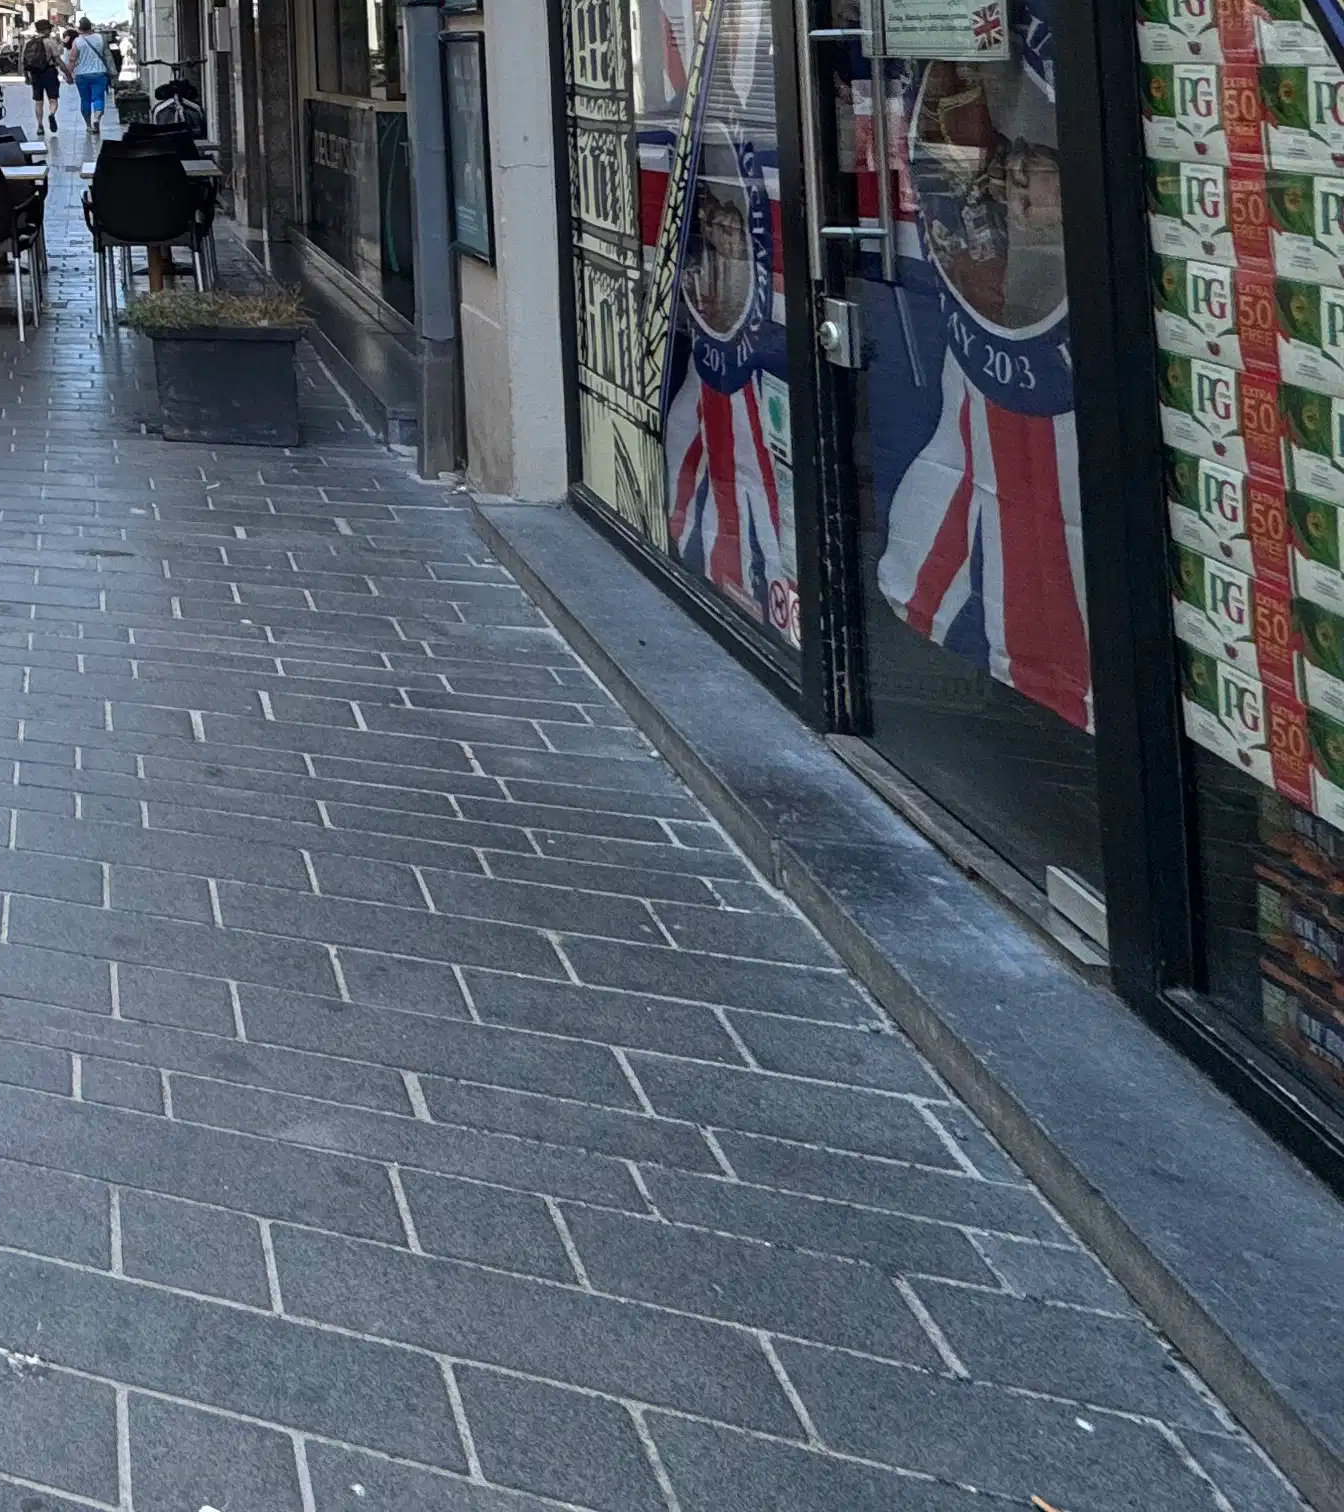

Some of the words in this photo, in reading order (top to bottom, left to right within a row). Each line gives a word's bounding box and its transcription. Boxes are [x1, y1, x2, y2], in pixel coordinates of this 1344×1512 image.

[1176, 77, 1212, 118] PG
[1223, 89, 1257, 120] 50
[1186, 176, 1220, 219] PG
[1231, 193, 1266, 226] 50
[1191, 273, 1227, 320] PG
[1238, 295, 1273, 329] 50
[1197, 372, 1232, 421] PG
[1243, 401, 1277, 438] 50
[1204, 472, 1239, 524] PG
[1250, 503, 1285, 541] 50
[1208, 571, 1245, 626] PG
[1255, 607, 1290, 646] 50
[1222, 676, 1262, 733] PG
[1270, 714, 1306, 758] 50
